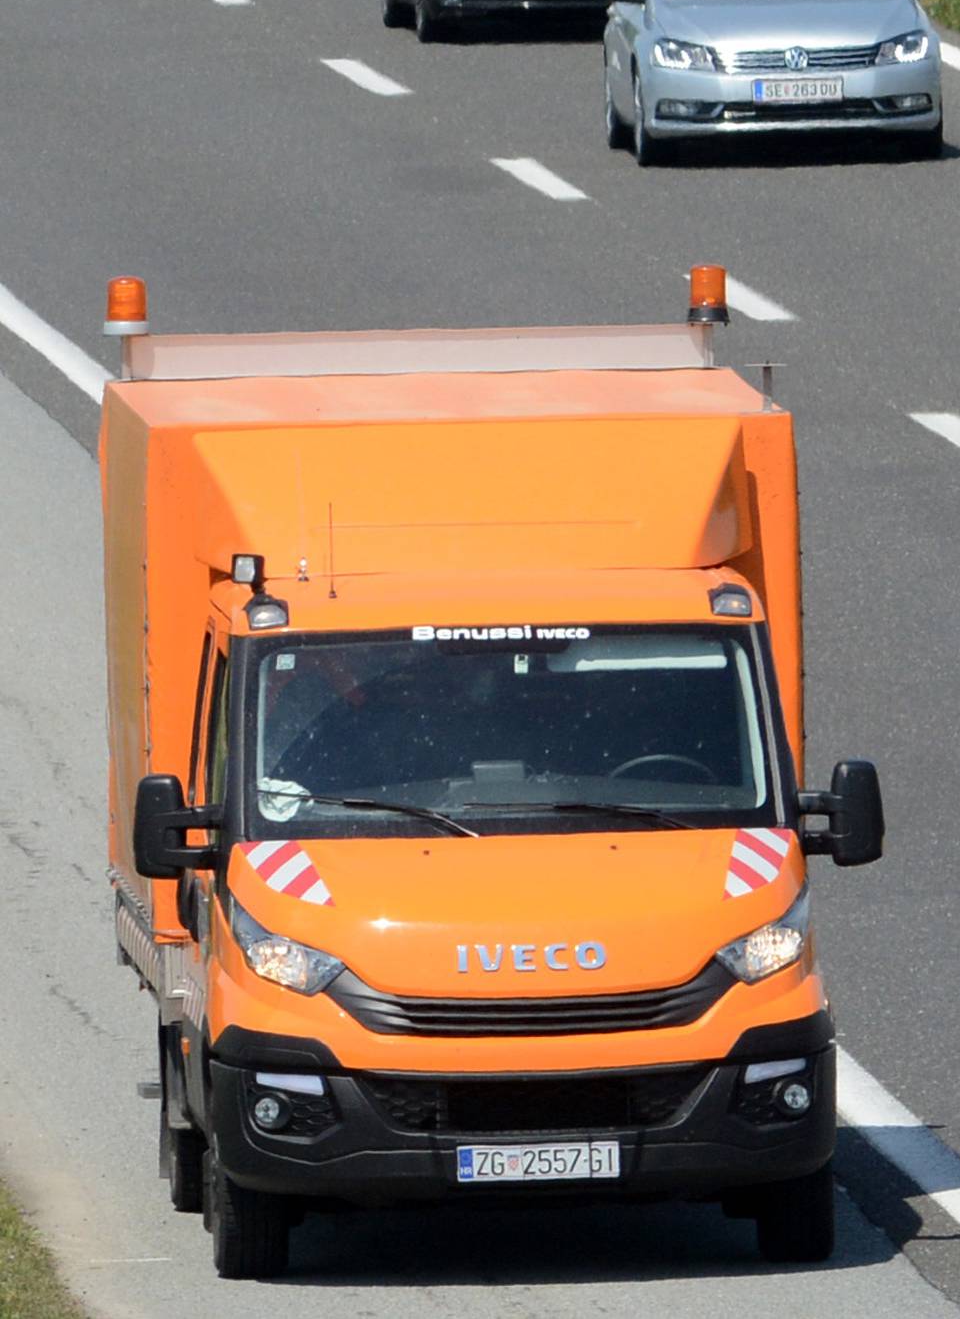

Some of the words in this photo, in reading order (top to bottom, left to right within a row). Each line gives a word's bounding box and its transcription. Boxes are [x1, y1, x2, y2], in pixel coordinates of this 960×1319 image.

[412, 625, 532, 641] Benussi
[536, 627, 590, 640] IVECO
[456, 941, 608, 973] IVECO
[476, 1152, 504, 1176] ZG
